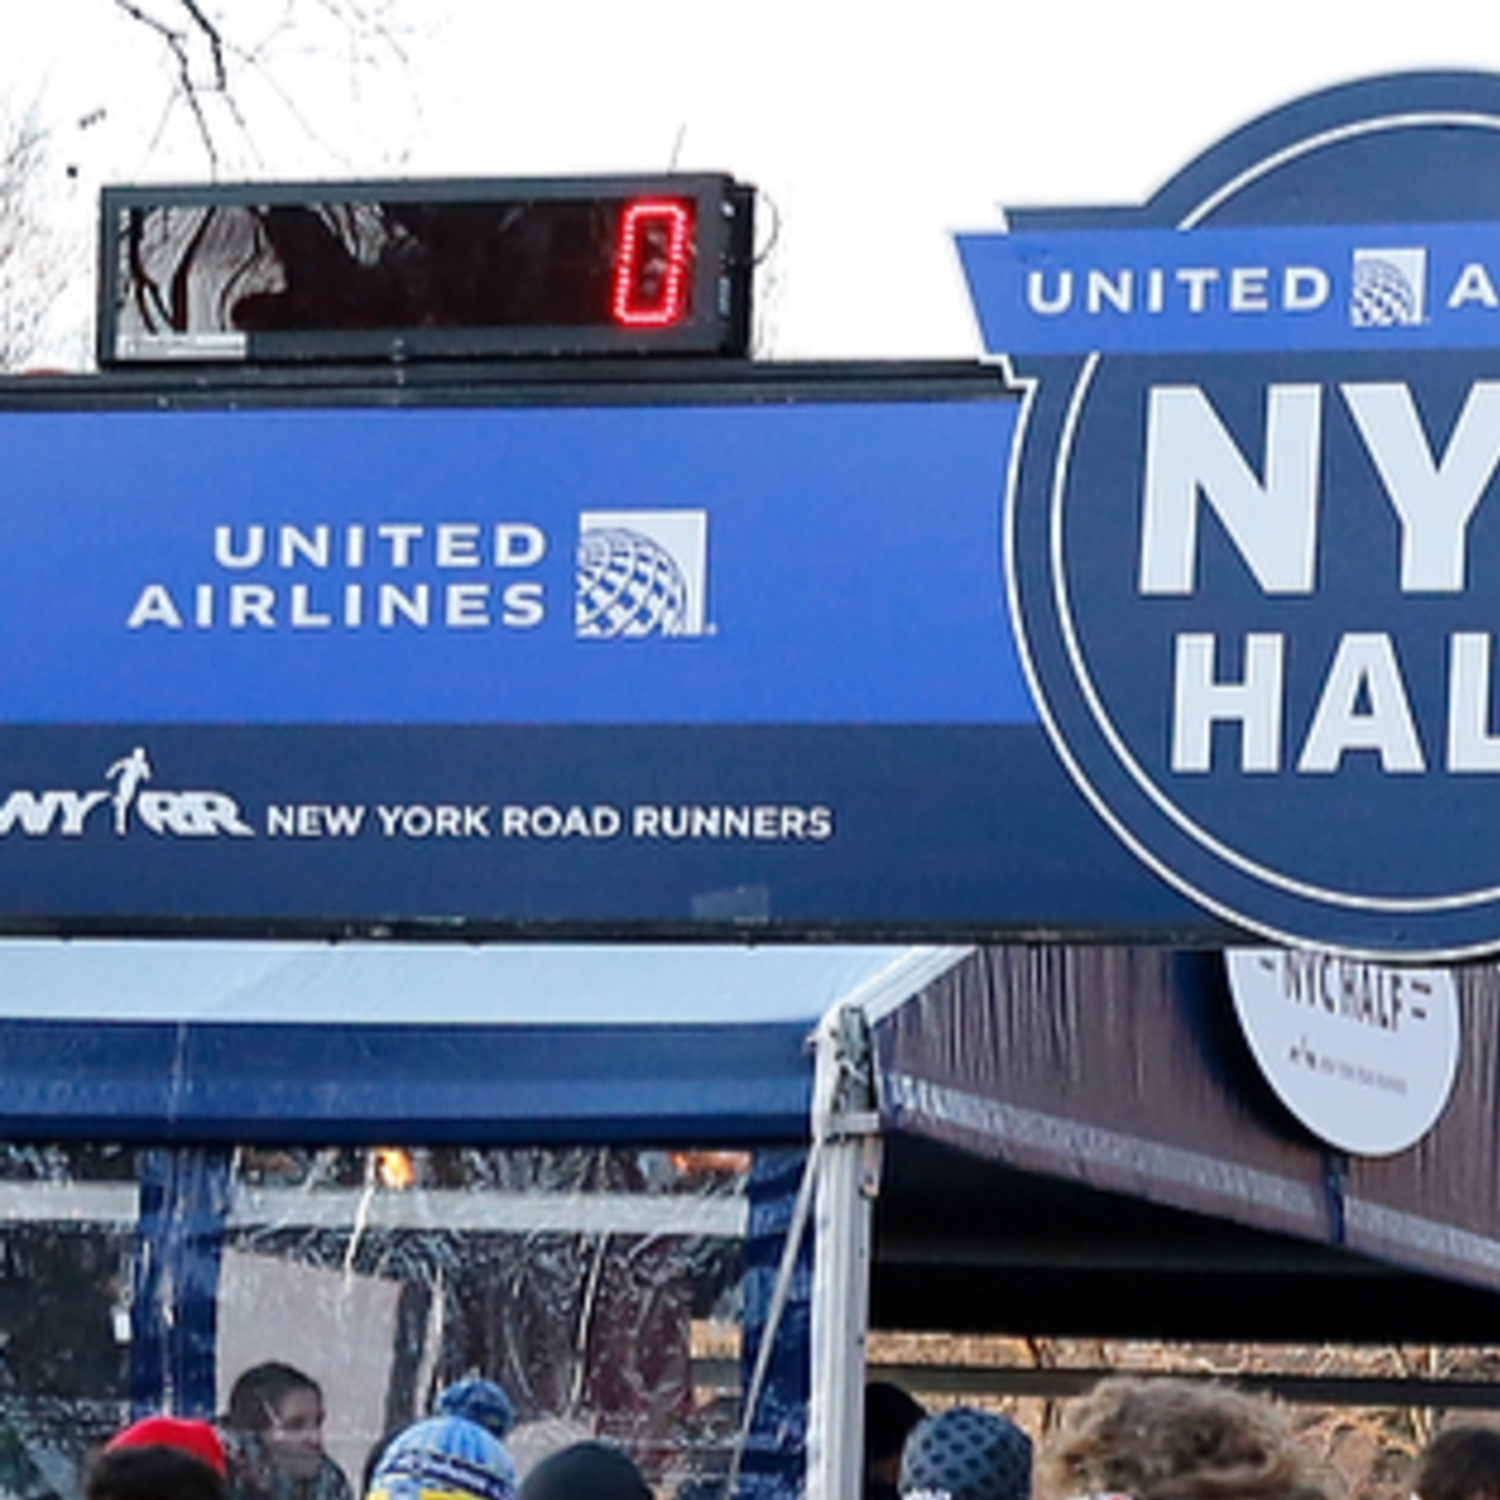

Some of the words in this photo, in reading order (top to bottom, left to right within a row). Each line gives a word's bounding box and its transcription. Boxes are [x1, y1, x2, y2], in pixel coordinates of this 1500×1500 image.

[614, 202, 687, 325] 0
[1028, 267, 1330, 314] UNITED
[215, 523, 545, 568] UNITED
[128, 583, 544, 627] AIRLINES
[267, 805, 368, 837] NEW
[377, 805, 490, 837] YORK
[502, 805, 620, 837] ROAD
[633, 806, 831, 838] RUNNERS
